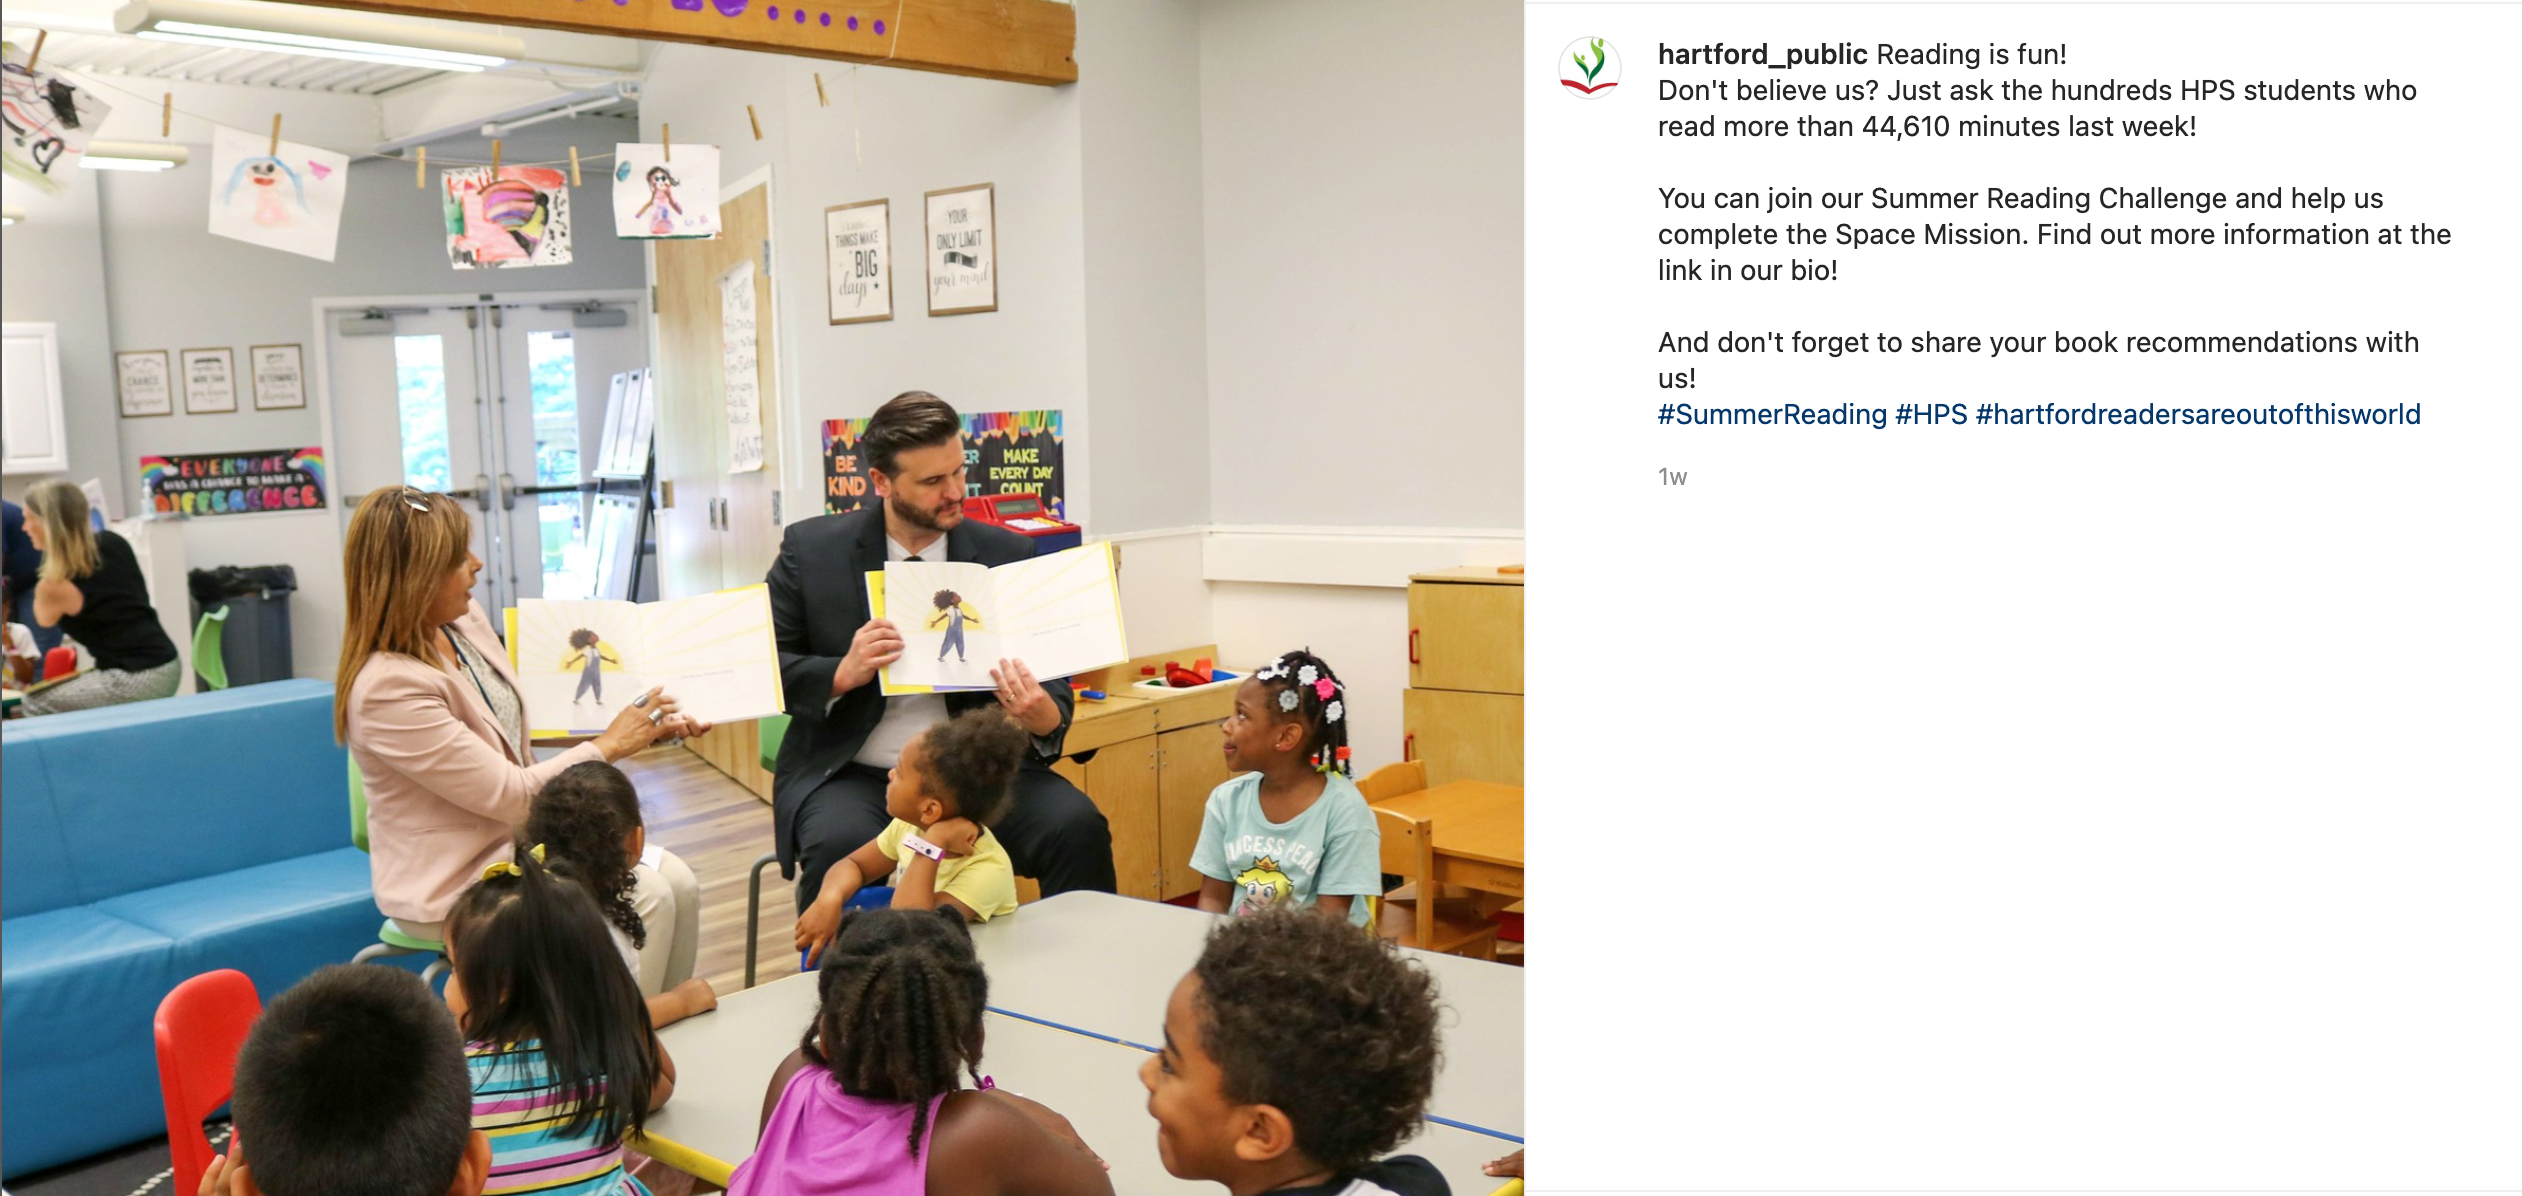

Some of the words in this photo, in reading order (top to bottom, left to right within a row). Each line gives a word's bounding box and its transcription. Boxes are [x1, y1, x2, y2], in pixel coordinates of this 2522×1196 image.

[947, 208, 968, 225] YOUR
[835, 232, 858, 249] THINGS
[859, 229, 878, 246] MAKE
[937, 233, 958, 251] ONLY
[959, 229, 982, 248] LIMIT
[855, 249, 878, 279] BIG
[839, 270, 867, 309] days
[933, 272, 956, 297] your
[960, 261, 989, 285] mind
[181, 456, 284, 477] EVERYONE
[835, 455, 857, 472] BE
[1003, 448, 1039, 464] MAKE
[163, 480, 188, 490] HAS
[201, 476, 242, 489] CHANCE
[245, 477, 258, 486] TO
[261, 475, 293, 485] MAKE
[989, 467, 1029, 480] EVERY
[1032, 466, 1054, 479] DAY
[828, 476, 867, 497] KIND
[1000, 482, 1044, 497] COUNT
[154, 486, 317, 513] DIFFERENCE
[1225, 835, 1286, 861] INCESS
[1285, 841, 1321, 875] PEAC
